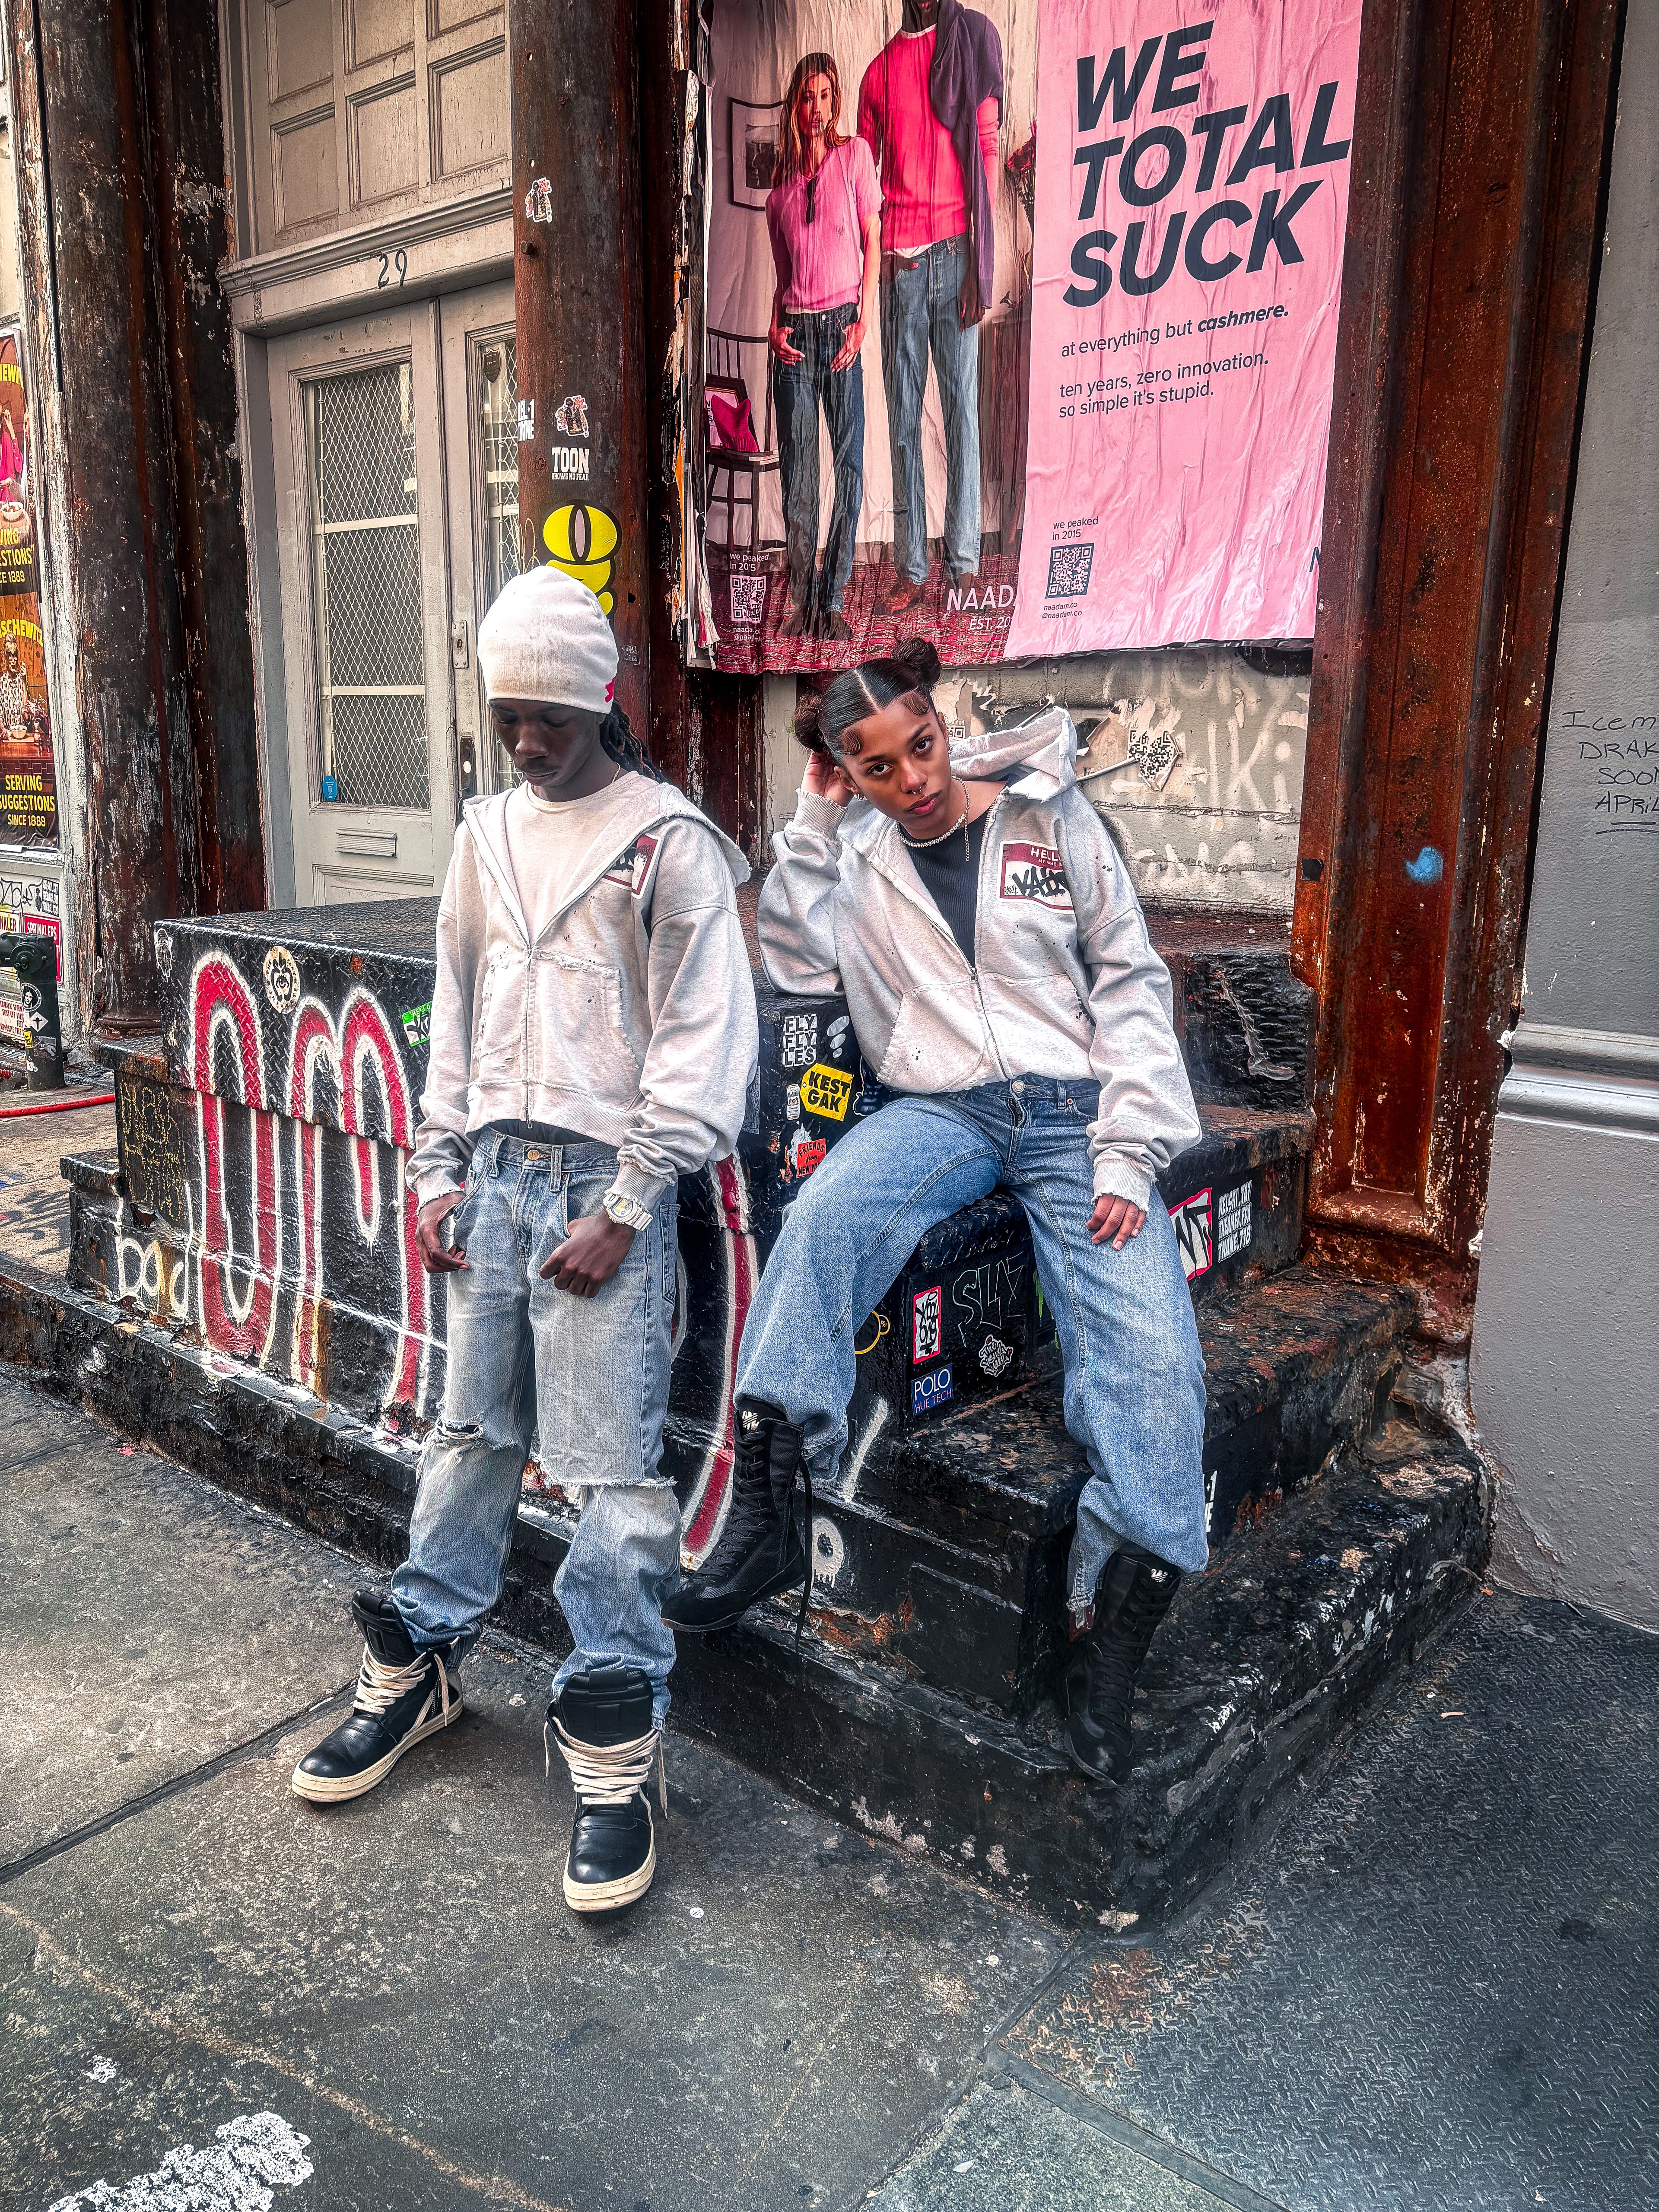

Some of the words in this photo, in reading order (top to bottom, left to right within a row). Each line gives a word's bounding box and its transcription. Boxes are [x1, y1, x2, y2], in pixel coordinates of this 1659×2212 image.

[1077, 20, 1214, 132] WE
[1073, 81, 1351, 220] TOTAL
[1063, 180, 1324, 307] SUCK
[378, 249, 407, 289] 29
[1062, 344, 1074, 357] at
[1079, 328, 1160, 353] everything
[1166, 320, 1192, 338] but
[1198, 305, 1289, 333] cashmere.
[1060, 383, 1082, 398] ten
[1087, 375, 1132, 397] years,
[1137, 369, 1172, 385] zero
[1177, 353, 1268, 379] innovation.
[1059, 404, 1075, 418] so
[1080, 394, 1129, 415] simple
[1133, 389, 1154, 406] it's
[1160, 381, 1214, 403] stupid.
[552, 447, 589, 474] TOON
[1068, 516, 1098, 529] peaked
[1062, 529, 1081, 540] 2015
[743, 553, 769, 562] peaked
[8, 570, 25, 583] 1888
[947, 585, 1016, 611] NAAD
[1044, 602, 1078, 611] naadam.co
[1042, 610, 1082, 620] @naadam.co
[5, 775, 42, 791] SERVING
[8, 814, 26, 826] SINCE
[28, 815, 46, 827] 1888
[785, 1015, 815, 1033] FLY
[785, 1031, 814, 1049] FLY
[809, 1071, 851, 1097] KEST
[807, 1089, 842, 1112] GAK
[799, 1142, 825, 1158] FRIENDS
[798, 1165, 810, 1175] NEW
[915, 1369, 950, 1401] POLO
[915, 1394, 931, 1413] HUE
[932, 1389, 952, 1405] TECH
